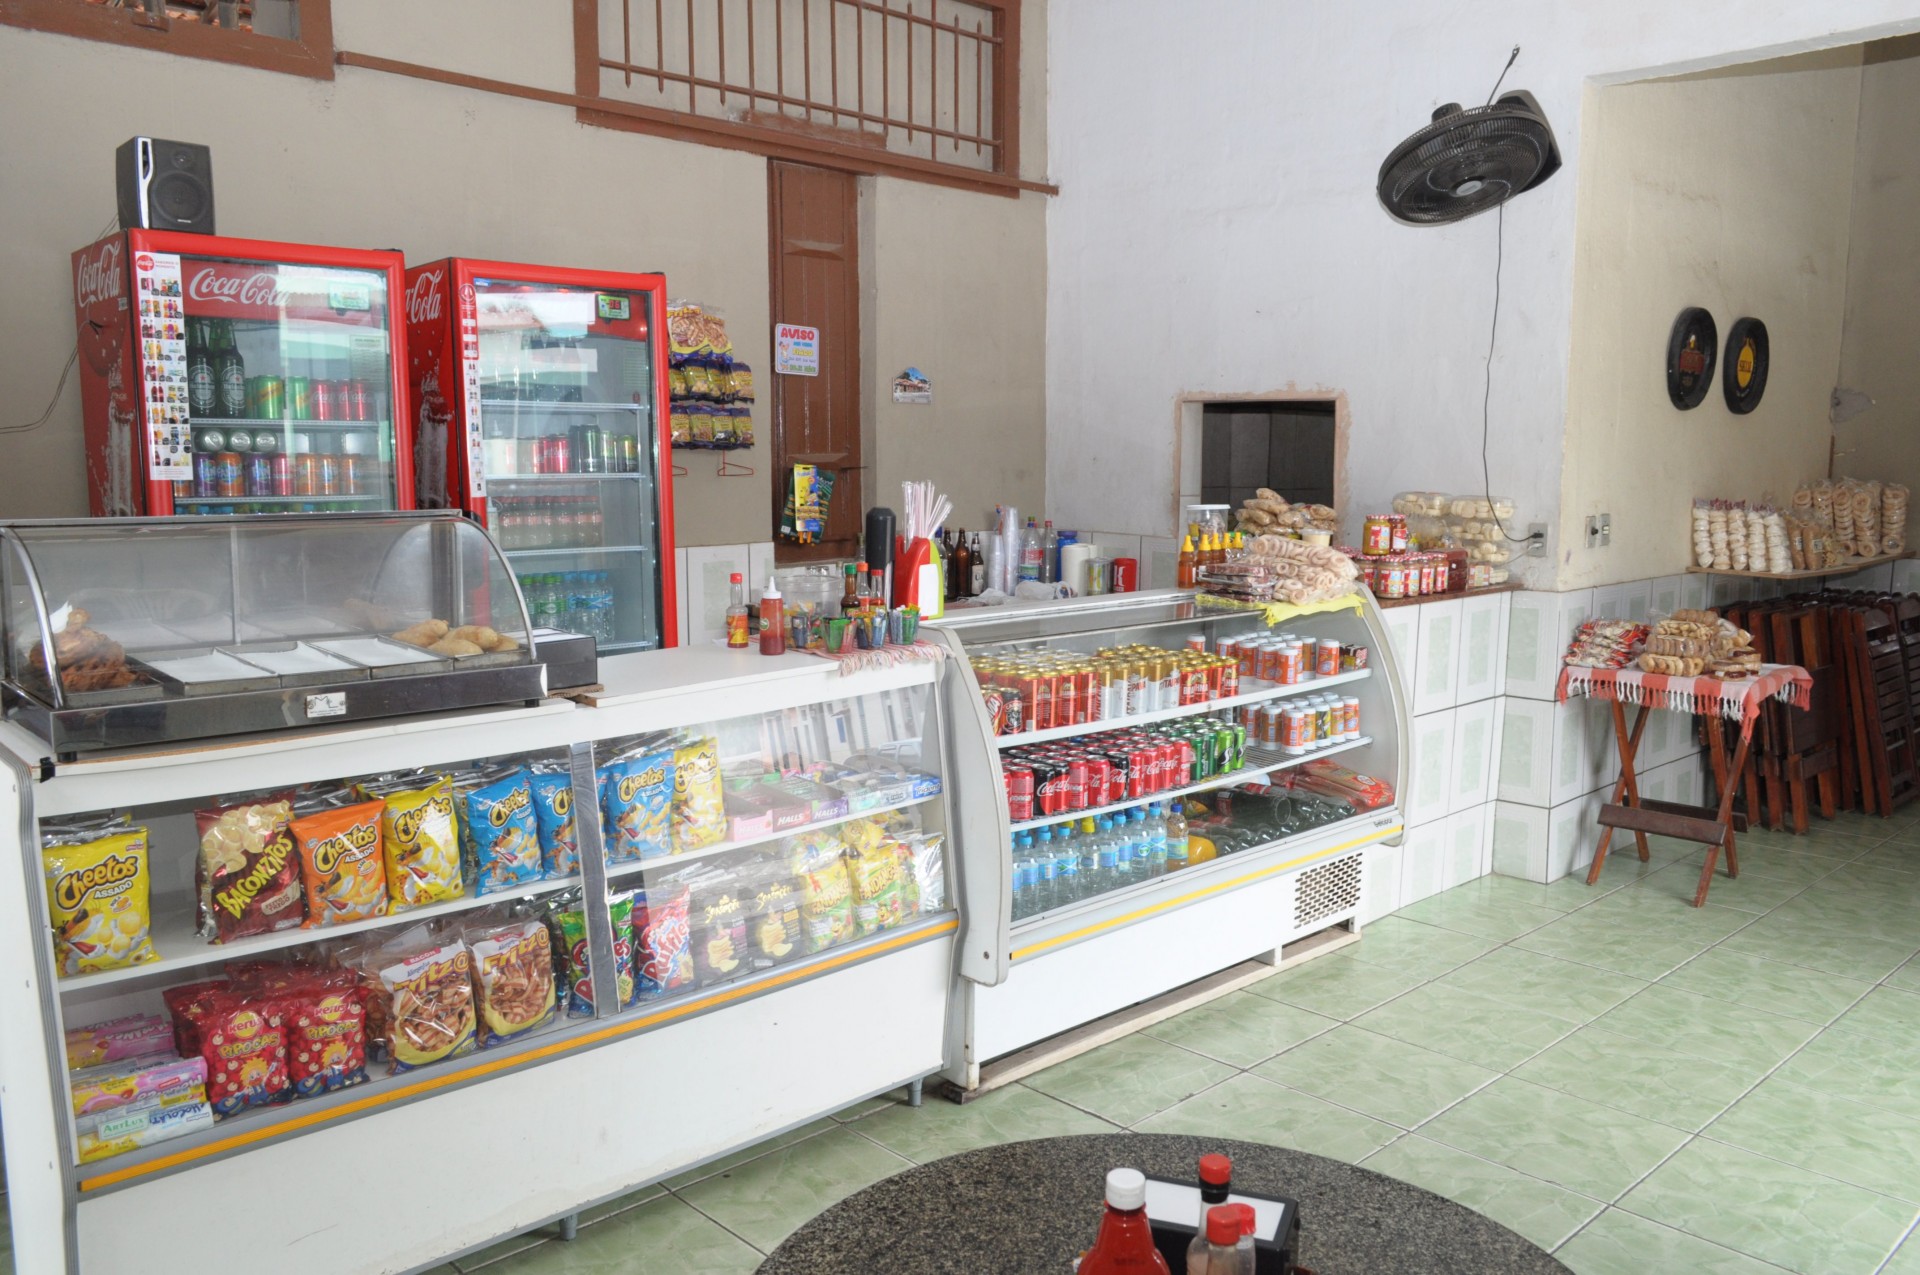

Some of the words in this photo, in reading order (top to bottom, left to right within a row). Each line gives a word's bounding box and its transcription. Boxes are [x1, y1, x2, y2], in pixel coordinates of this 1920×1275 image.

[78, 240, 121, 308] Coca-Cola
[190, 267, 290, 306] Coca-Cola
[405, 269, 444, 324] a-Cola
[781, 326, 815, 341] AVISO
[618, 766, 665, 803] Cheetos
[777, 812, 804, 827] HALLS
[815, 807, 839, 820] HALLS
[313, 823, 377, 874] Cheetos
[55, 853, 139, 912] Cheetos
[94, 880, 133, 899] ASSADO
[215, 834, 294, 920] BACONZITOS
[409, 950, 437, 965] BACON
[483, 926, 549, 976] Fritz@
[219, 1032, 280, 1058] PIPOCAS
